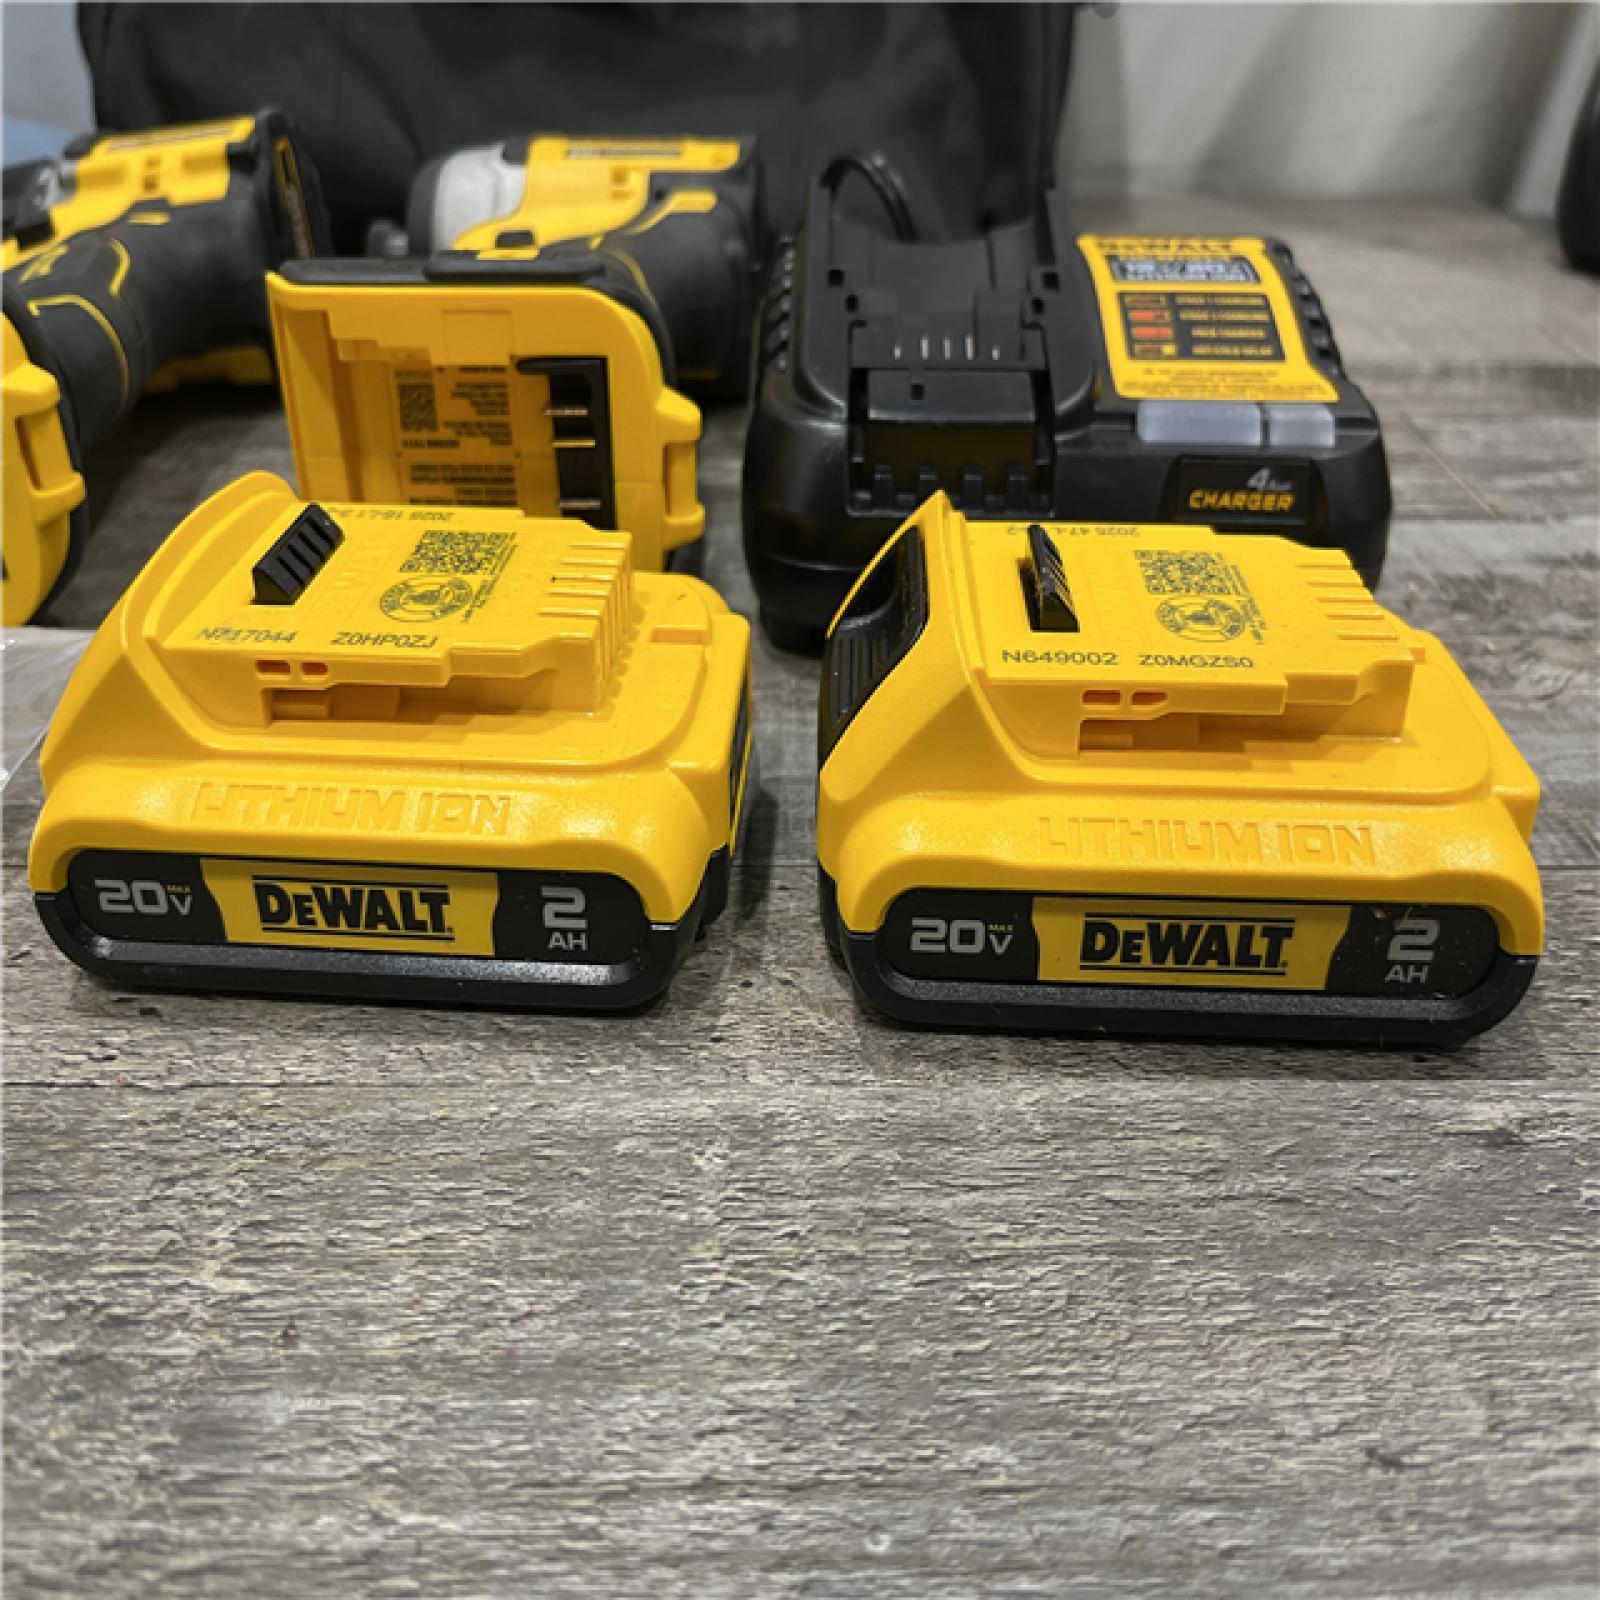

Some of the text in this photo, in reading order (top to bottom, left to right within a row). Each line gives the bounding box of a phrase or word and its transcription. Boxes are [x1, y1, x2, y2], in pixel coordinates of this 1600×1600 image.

[1188, 489, 1296, 512] CHARGER
[1001, 649, 1119, 667] N649002
[191, 782, 512, 836] LITHIUM ION
[1037, 816, 1377, 867] LITHIUM ION
[253, 882, 453, 933] DEWALT
[541, 886, 587, 929] 2
[548, 931, 588, 951] AH
[1080, 918, 1293, 969] DEWALT
[1387, 918, 1440, 961] 2
[1384, 964, 1430, 983] AH
